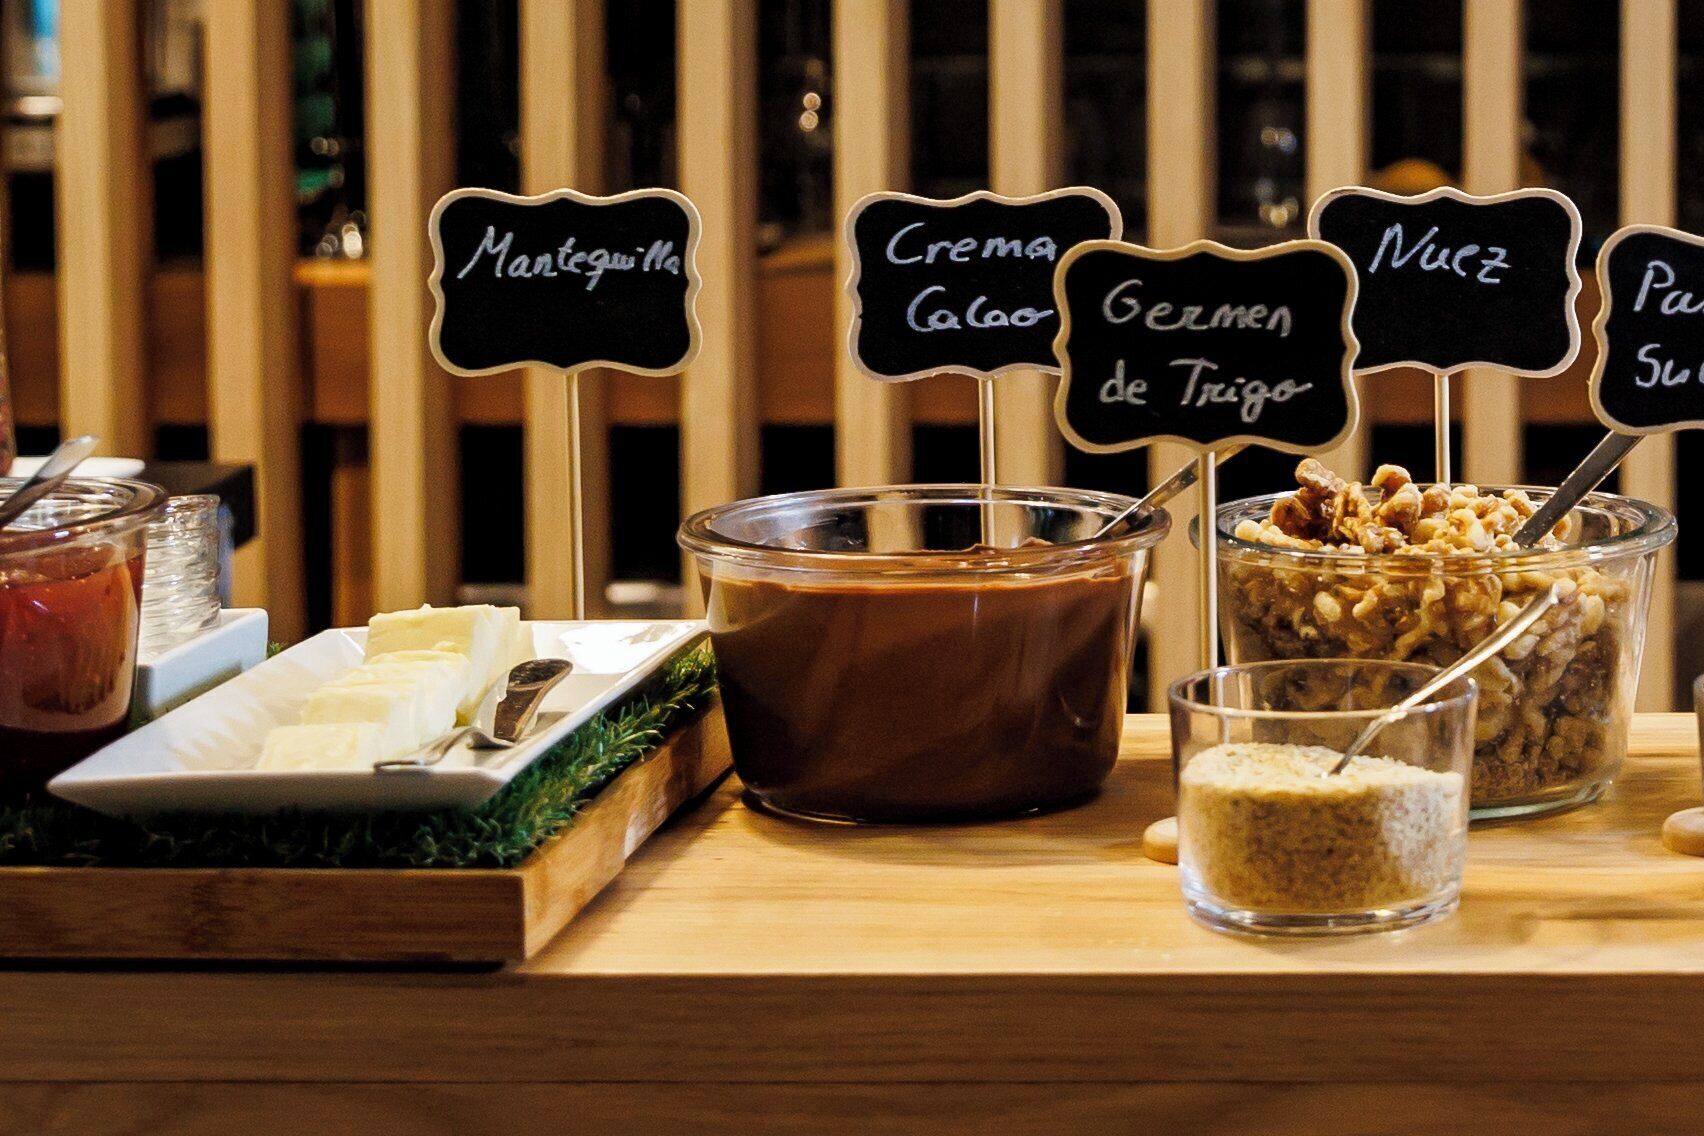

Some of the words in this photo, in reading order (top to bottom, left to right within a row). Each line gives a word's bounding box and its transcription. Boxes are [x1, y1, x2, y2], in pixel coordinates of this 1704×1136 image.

[457, 226, 679, 290] Mantequilla
[887, 222, 1057, 264] Crema
[1369, 223, 1511, 283] Nuez
[1104, 280, 1290, 336] Germen
[1101, 360, 1146, 404] de
[1170, 359, 1312, 422] Trigo
